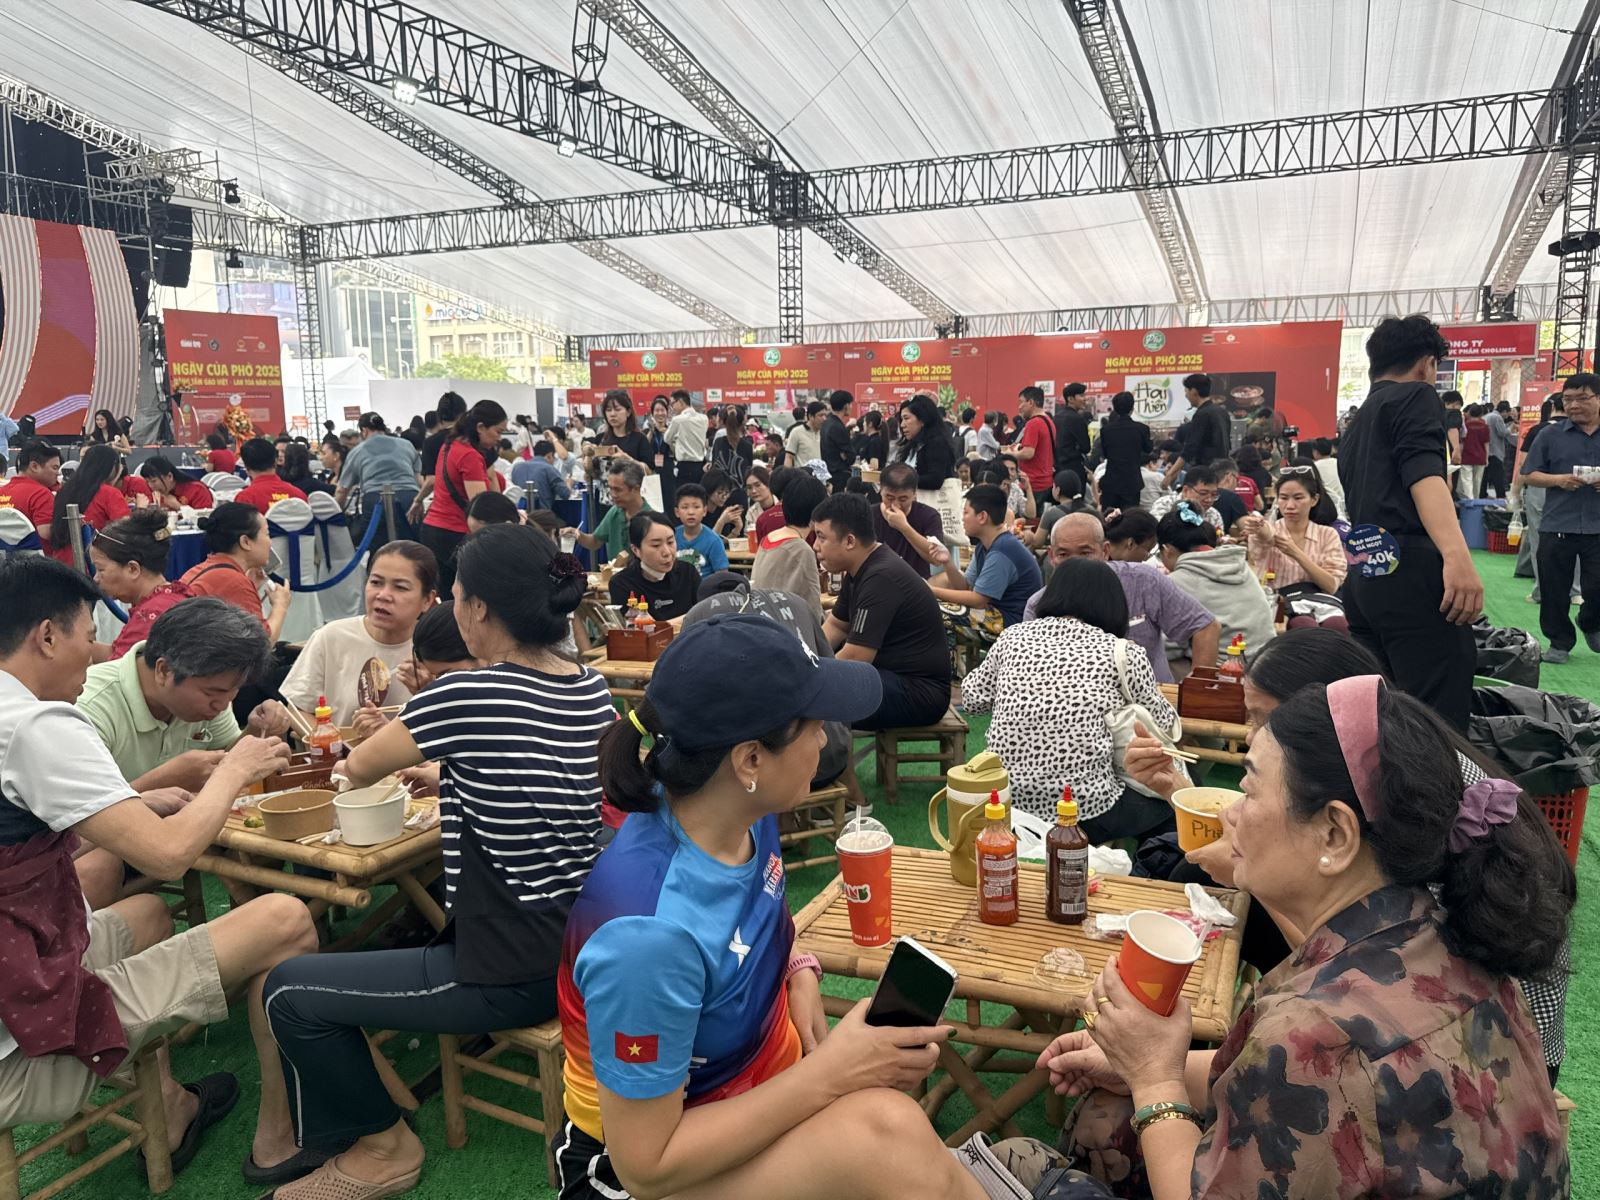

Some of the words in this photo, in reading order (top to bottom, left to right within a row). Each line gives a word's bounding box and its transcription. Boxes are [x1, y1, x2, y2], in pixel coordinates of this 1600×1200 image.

[1133, 355, 1152, 366] CỦA
[1155, 353, 1176, 365] PHỞ
[1178, 354, 1203, 365] 2025
[172, 361, 204, 375] NGÀY
[206, 361, 229, 376] CỦA
[231, 362, 254, 377] PHỞ
[255, 365, 280, 377] 2025
[931, 365, 952, 374] 2025
[666, 373, 682, 381] 2025
[790, 370, 808, 378] 2025
